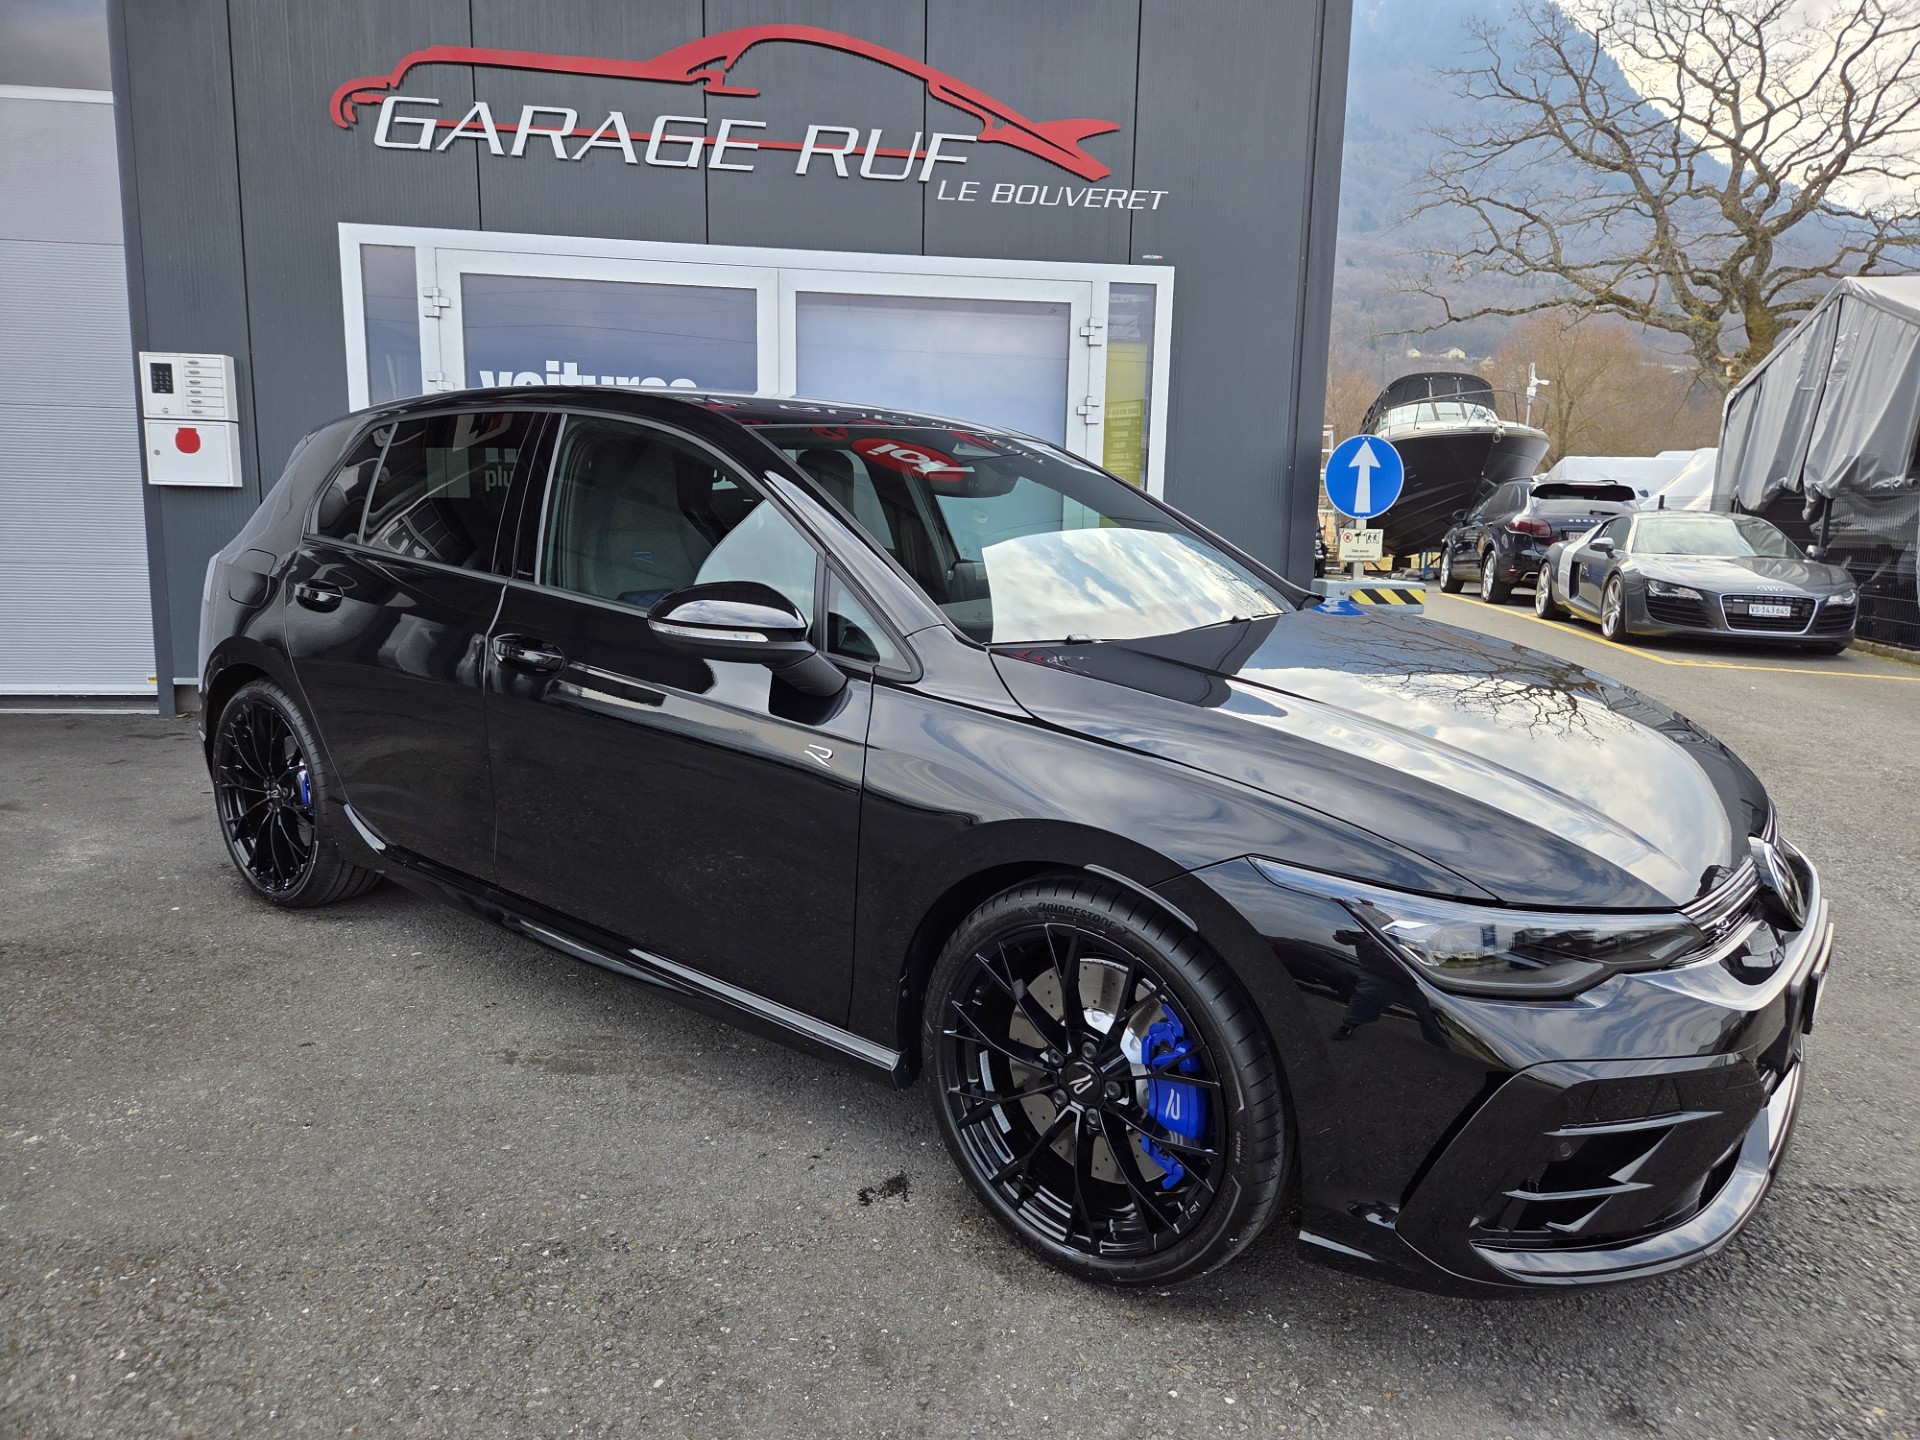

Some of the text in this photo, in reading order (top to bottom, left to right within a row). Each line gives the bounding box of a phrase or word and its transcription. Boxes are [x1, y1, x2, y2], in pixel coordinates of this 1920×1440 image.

[373, 95, 977, 183] GARAGE RUF
[937, 179, 1169, 211] LE BOUVERET
[1750, 605, 1760, 613] VS
[1037, 902, 1118, 929] BRIDGESTONE
